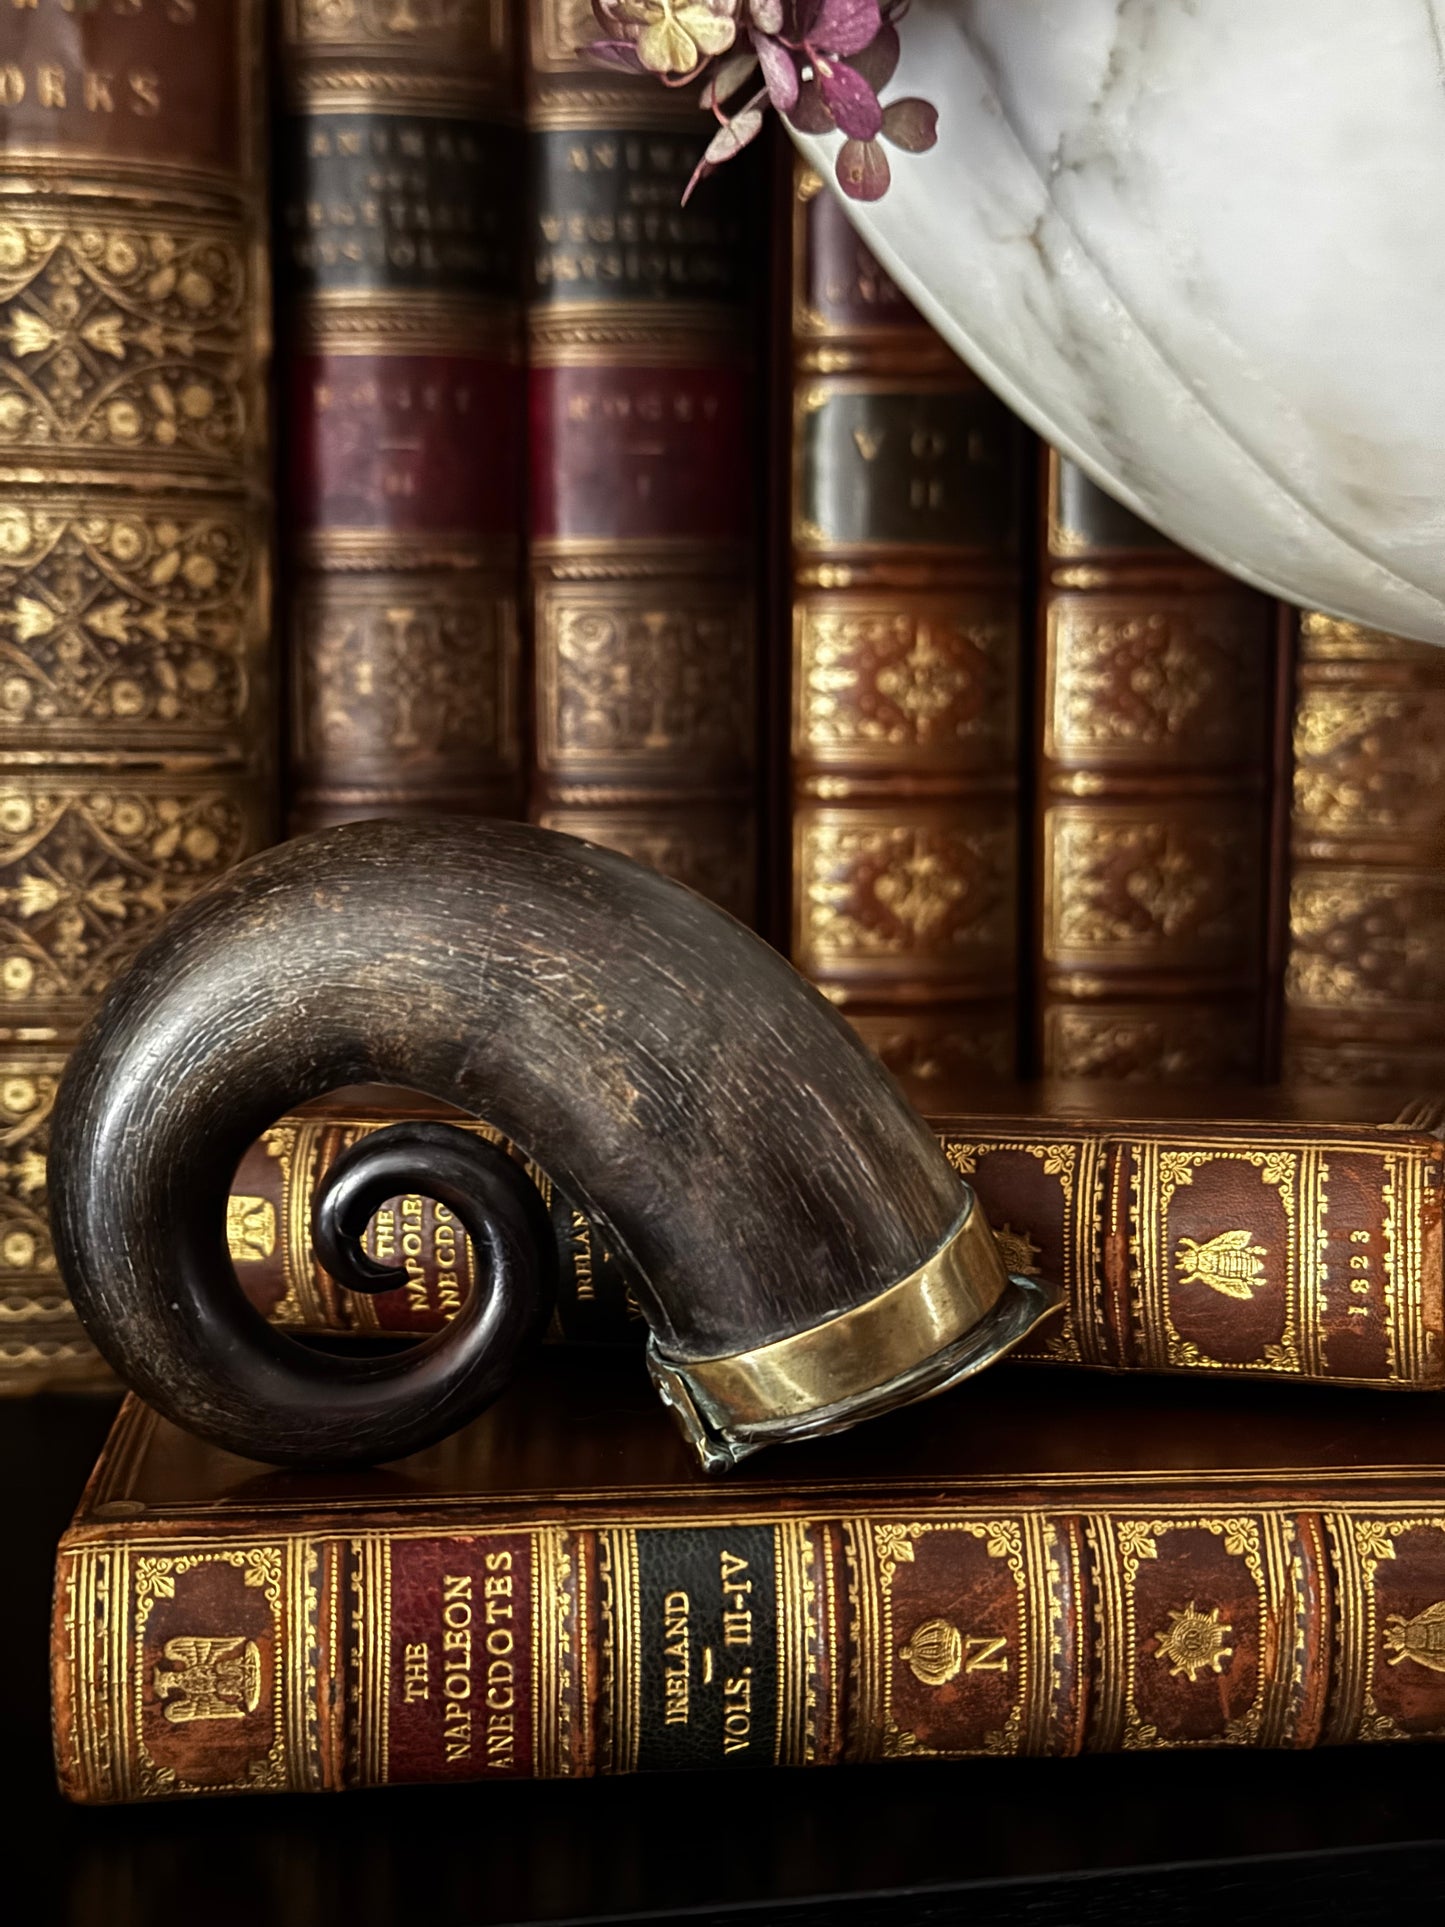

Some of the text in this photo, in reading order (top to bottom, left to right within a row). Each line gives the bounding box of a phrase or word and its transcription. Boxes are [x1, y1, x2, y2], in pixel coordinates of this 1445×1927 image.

[375, 1210, 395, 1259] THE
[402, 1193, 431, 1313] NAPOLE
[1348, 1230, 1371, 1317] 1823
[405, 1641, 428, 1704] THE
[443, 1574, 473, 1764] NAPOLEON
[486, 1551, 514, 1770] ANECDOTES
[664, 1591, 690, 1726] IRELAND
[720, 1551, 753, 1755] VOLS. III-IV
[965, 1636, 1008, 1674] N
